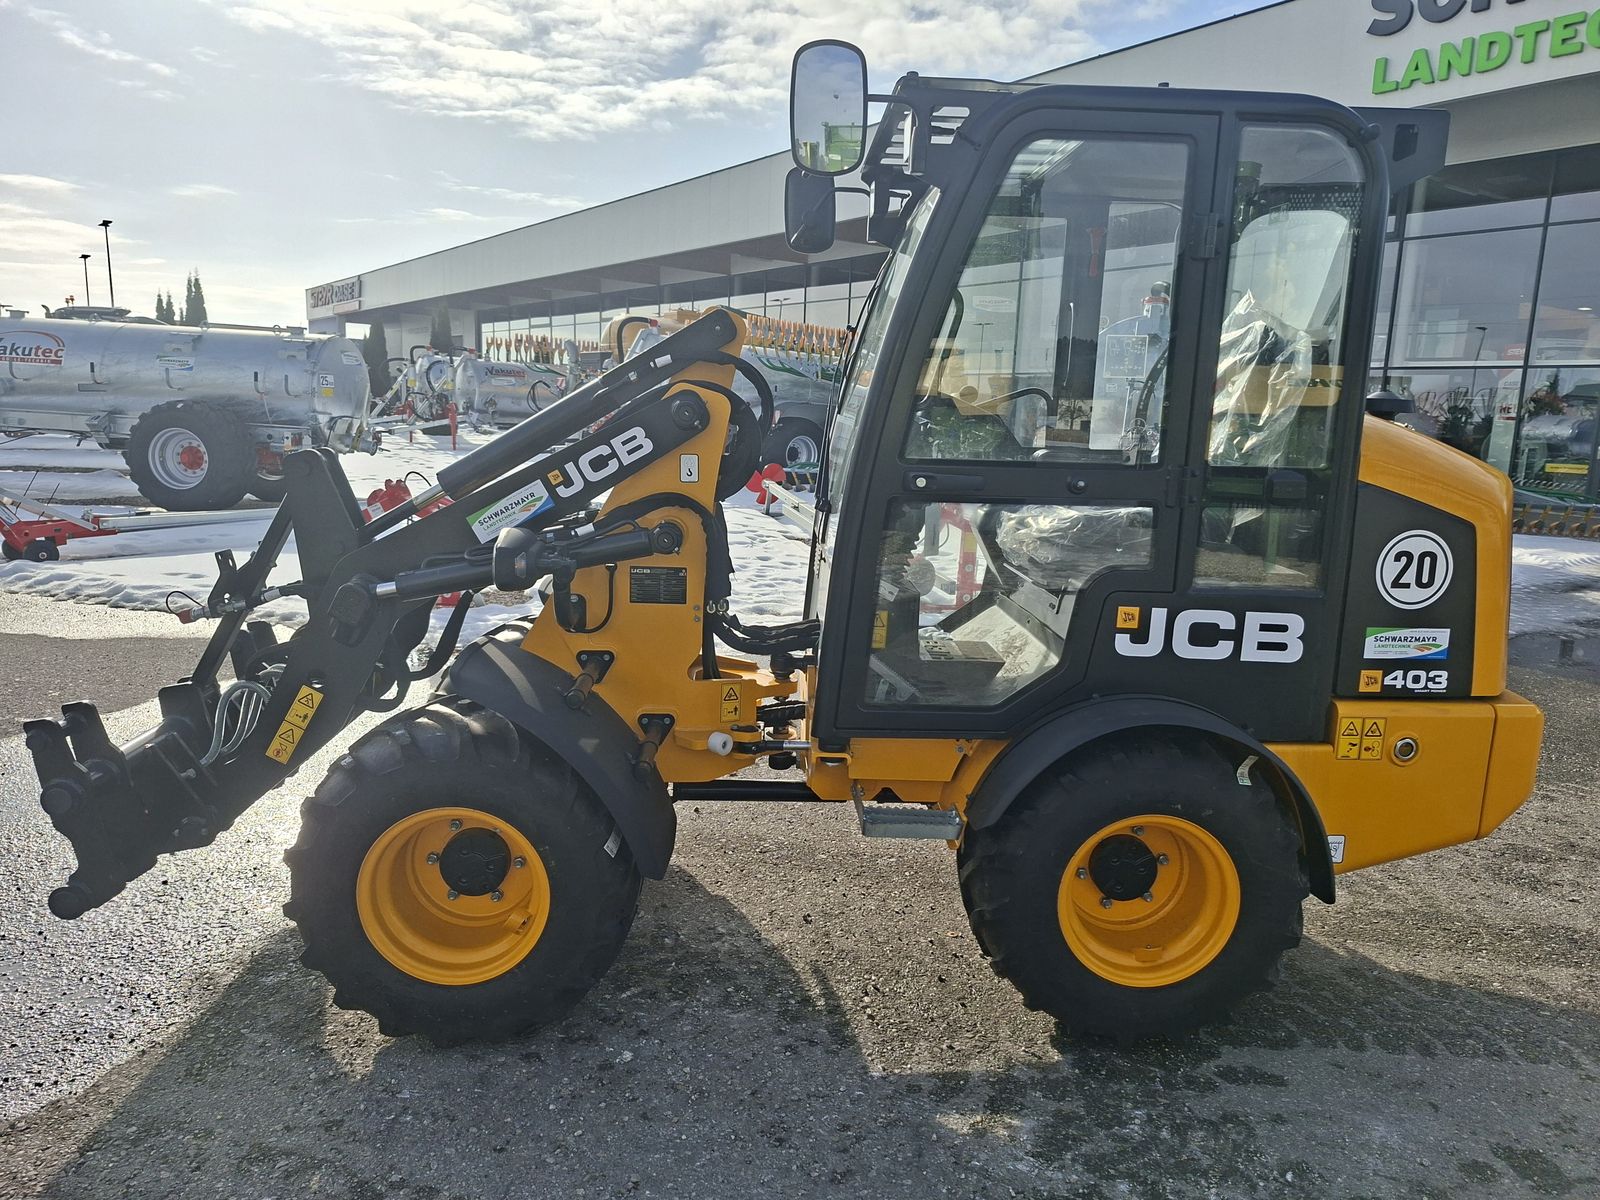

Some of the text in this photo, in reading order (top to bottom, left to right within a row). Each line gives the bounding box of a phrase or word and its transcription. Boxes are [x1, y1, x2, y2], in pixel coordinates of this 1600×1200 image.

[0, 336, 65, 359] akutec
[320, 375, 329, 386] 25
[555, 426, 654, 498] JCB
[477, 491, 536, 527] SCHWARZMAYR
[482, 510, 517, 532] LANDTECHNIK
[1390, 550, 1438, 590] 20
[1114, 606, 1305, 664] JCB
[1373, 635, 1438, 643] SCHWARZMAYR
[1383, 669, 1449, 690] 403
